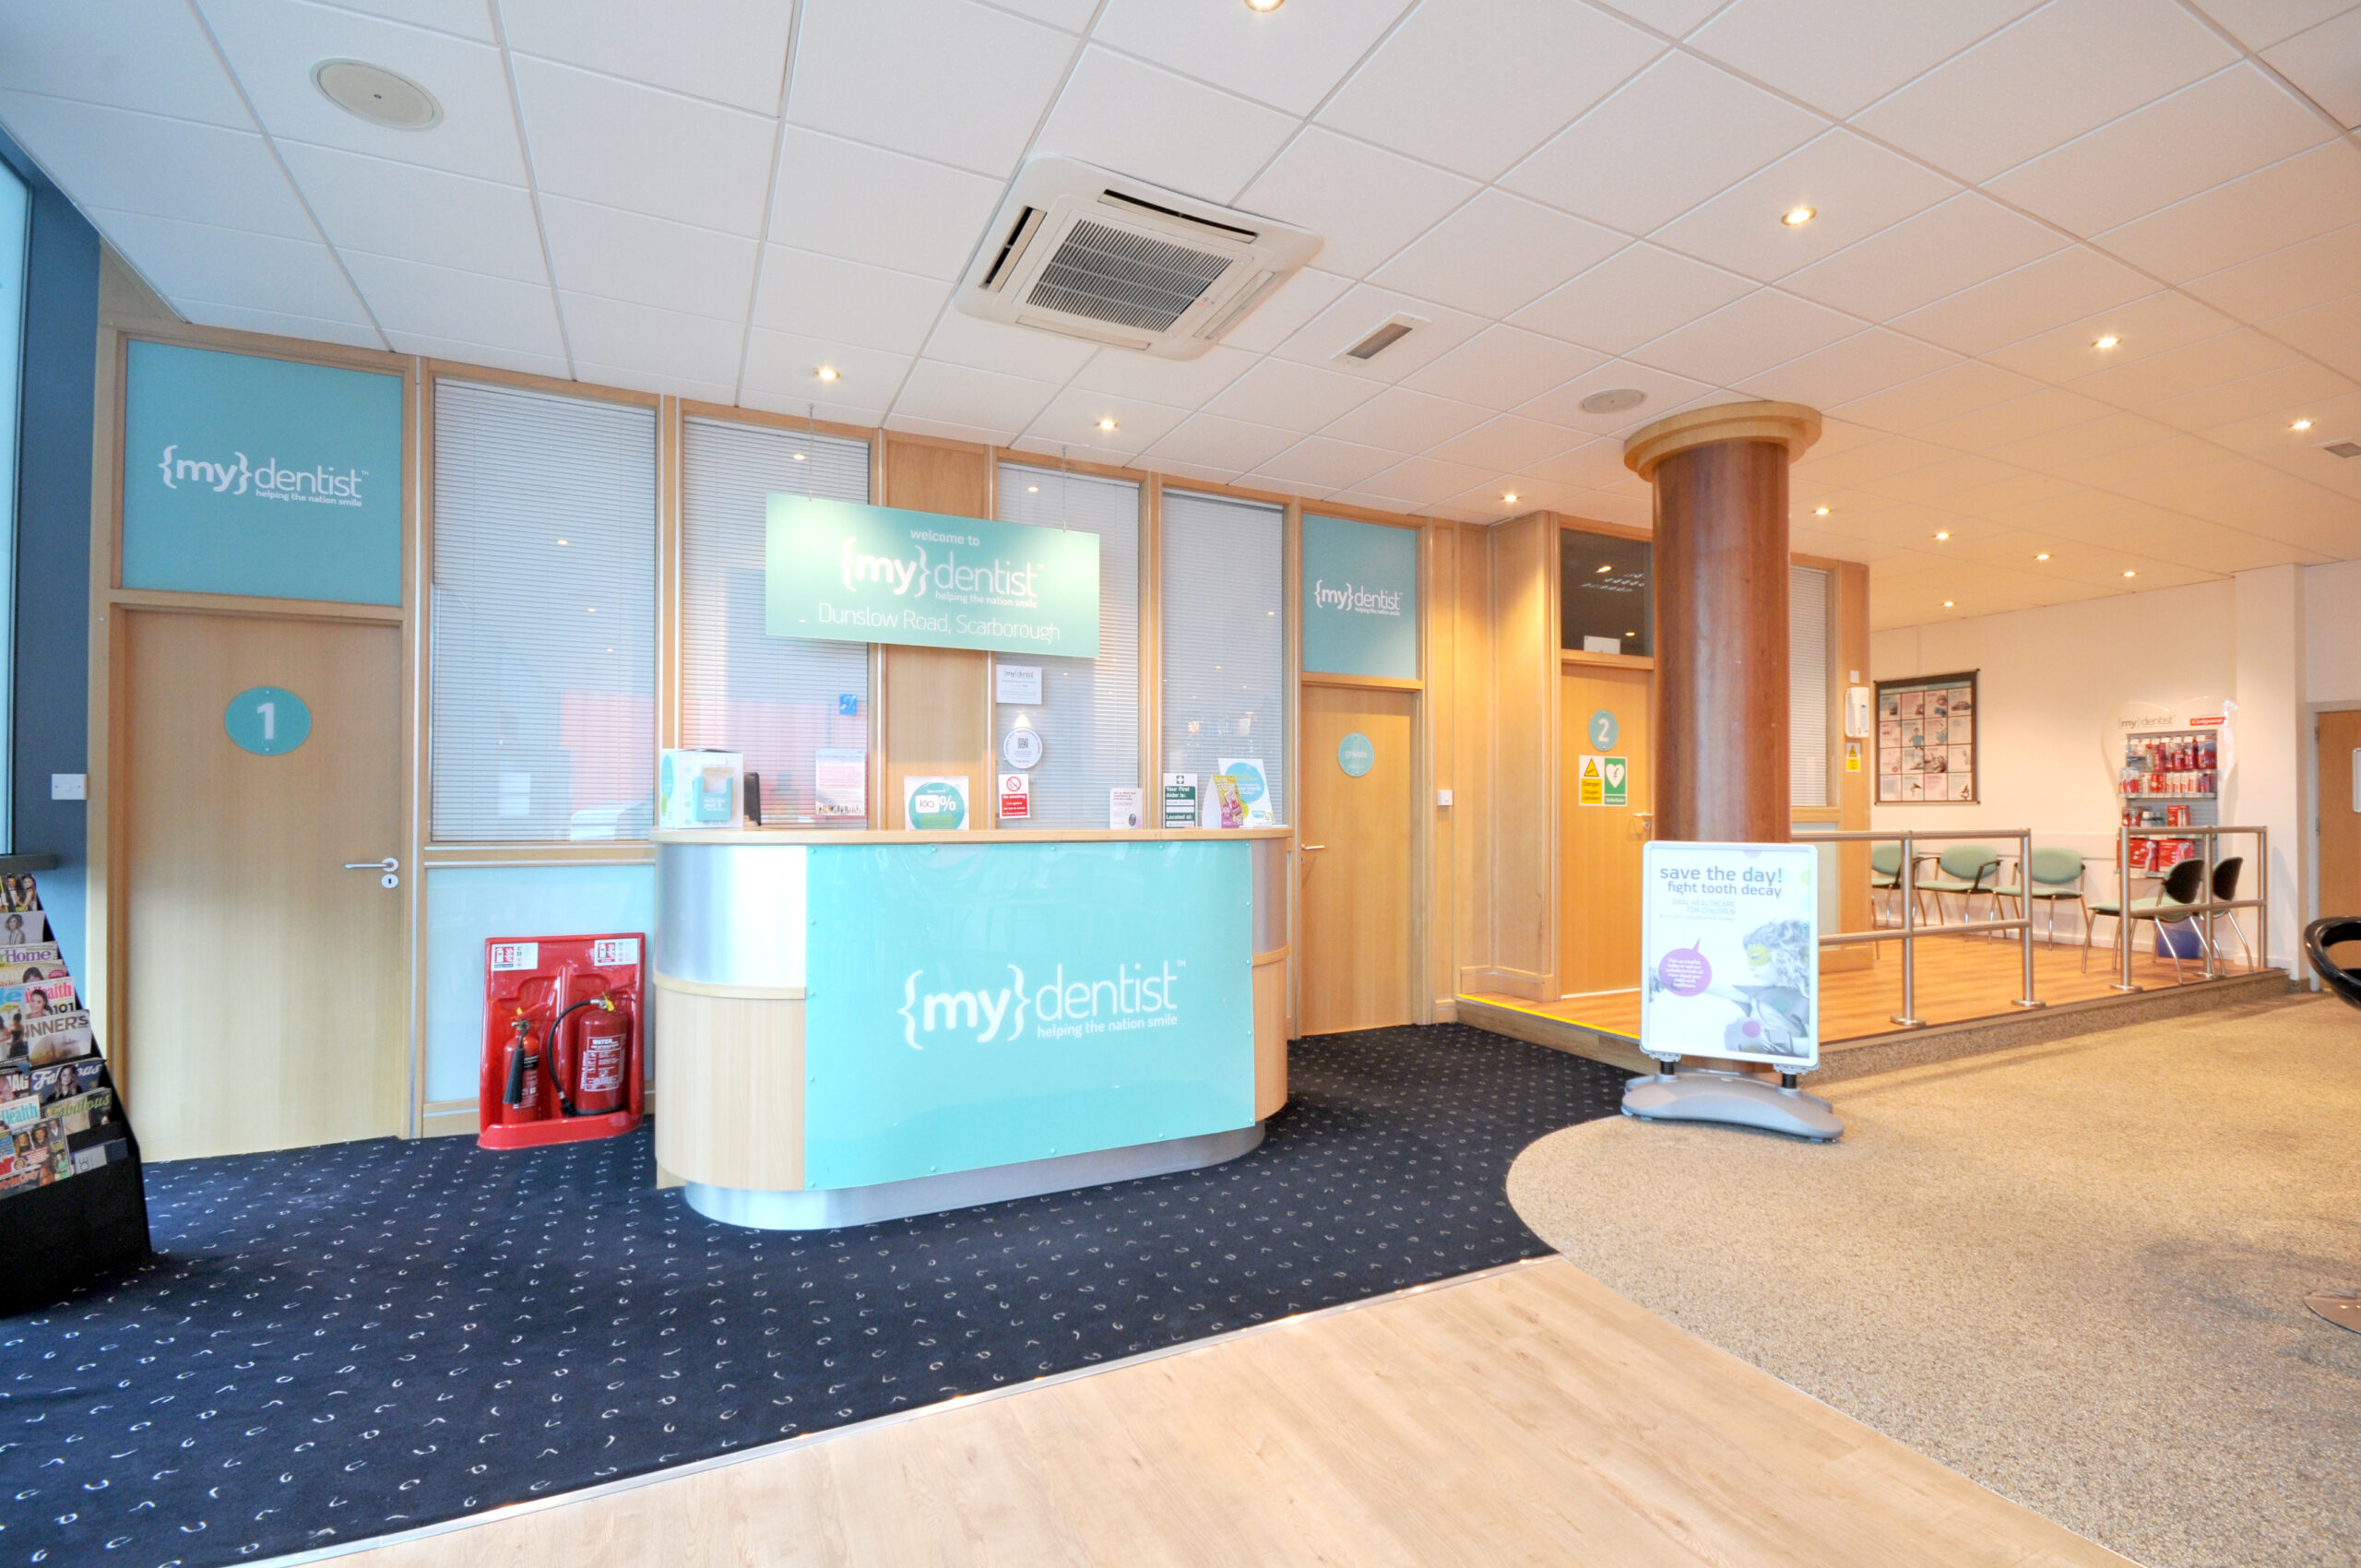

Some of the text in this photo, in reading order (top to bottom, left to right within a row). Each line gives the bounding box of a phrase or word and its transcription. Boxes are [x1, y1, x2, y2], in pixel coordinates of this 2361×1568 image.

[255, 488, 362, 507] helping the nation smile
[910, 529, 980, 547] welcome to
[935, 589, 1038, 609] helping the nation smile
[818, 602, 1061, 646] Dunslow Road, Scarborough
[256, 703, 275, 740] 1
[1597, 718, 1610, 742] 2
[1659, 865, 1782, 886] save the day!
[1667, 881, 1782, 899] fight tooth decay
[1691, 899, 1736, 909] HEALTHCARE
[1701, 907, 1736, 915] CHILDREN
[53, 1002, 74, 1015] 101
[1037, 1013, 1178, 1039] helping the nation smile
